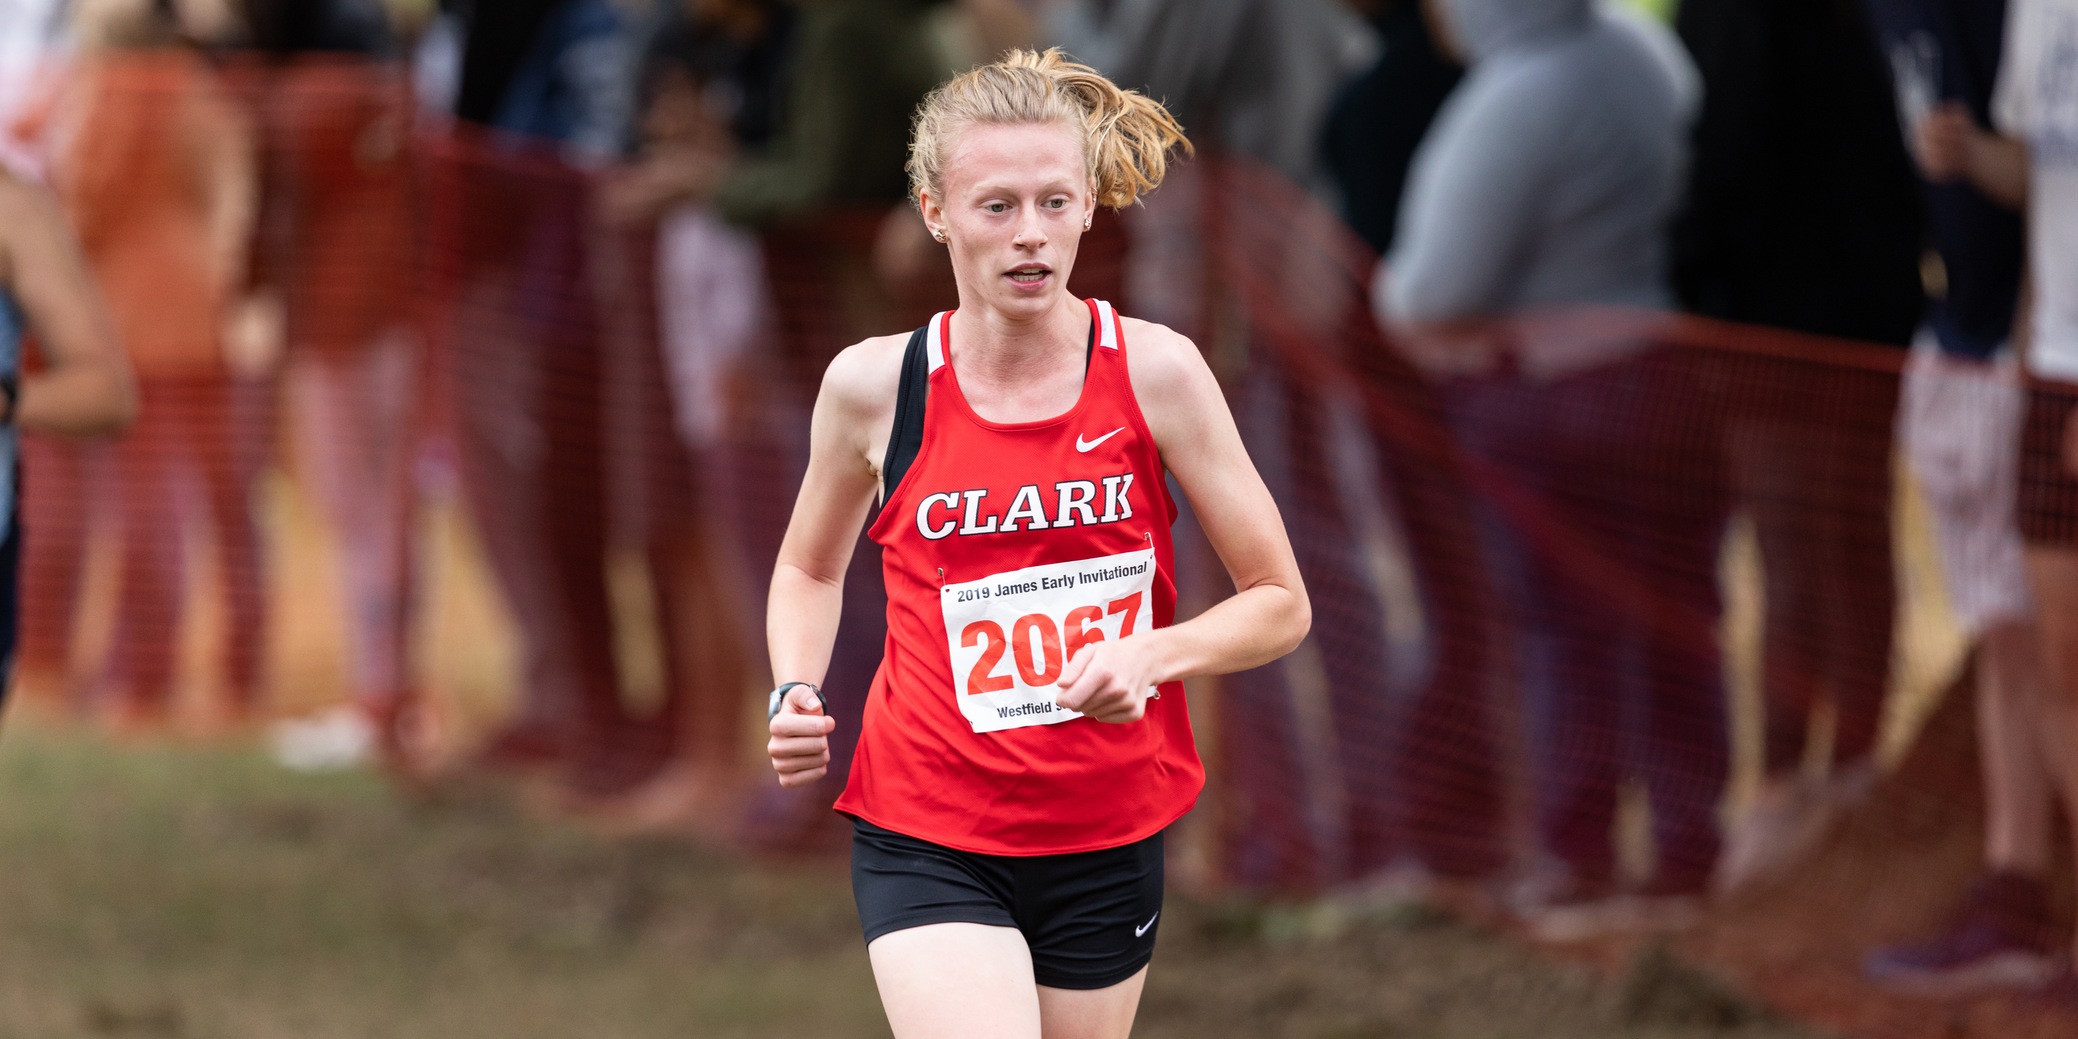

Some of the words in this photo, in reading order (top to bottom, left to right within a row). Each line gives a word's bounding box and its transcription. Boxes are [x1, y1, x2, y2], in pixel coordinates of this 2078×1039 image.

[916, 472, 1134, 541] CLARK
[957, 587, 990, 602] 2019
[994, 580, 1038, 598] James
[1041, 573, 1075, 592] Early
[1079, 561, 1148, 584] Invitational
[960, 591, 1143, 696] 2067
[997, 702, 1052, 719] Westfield
